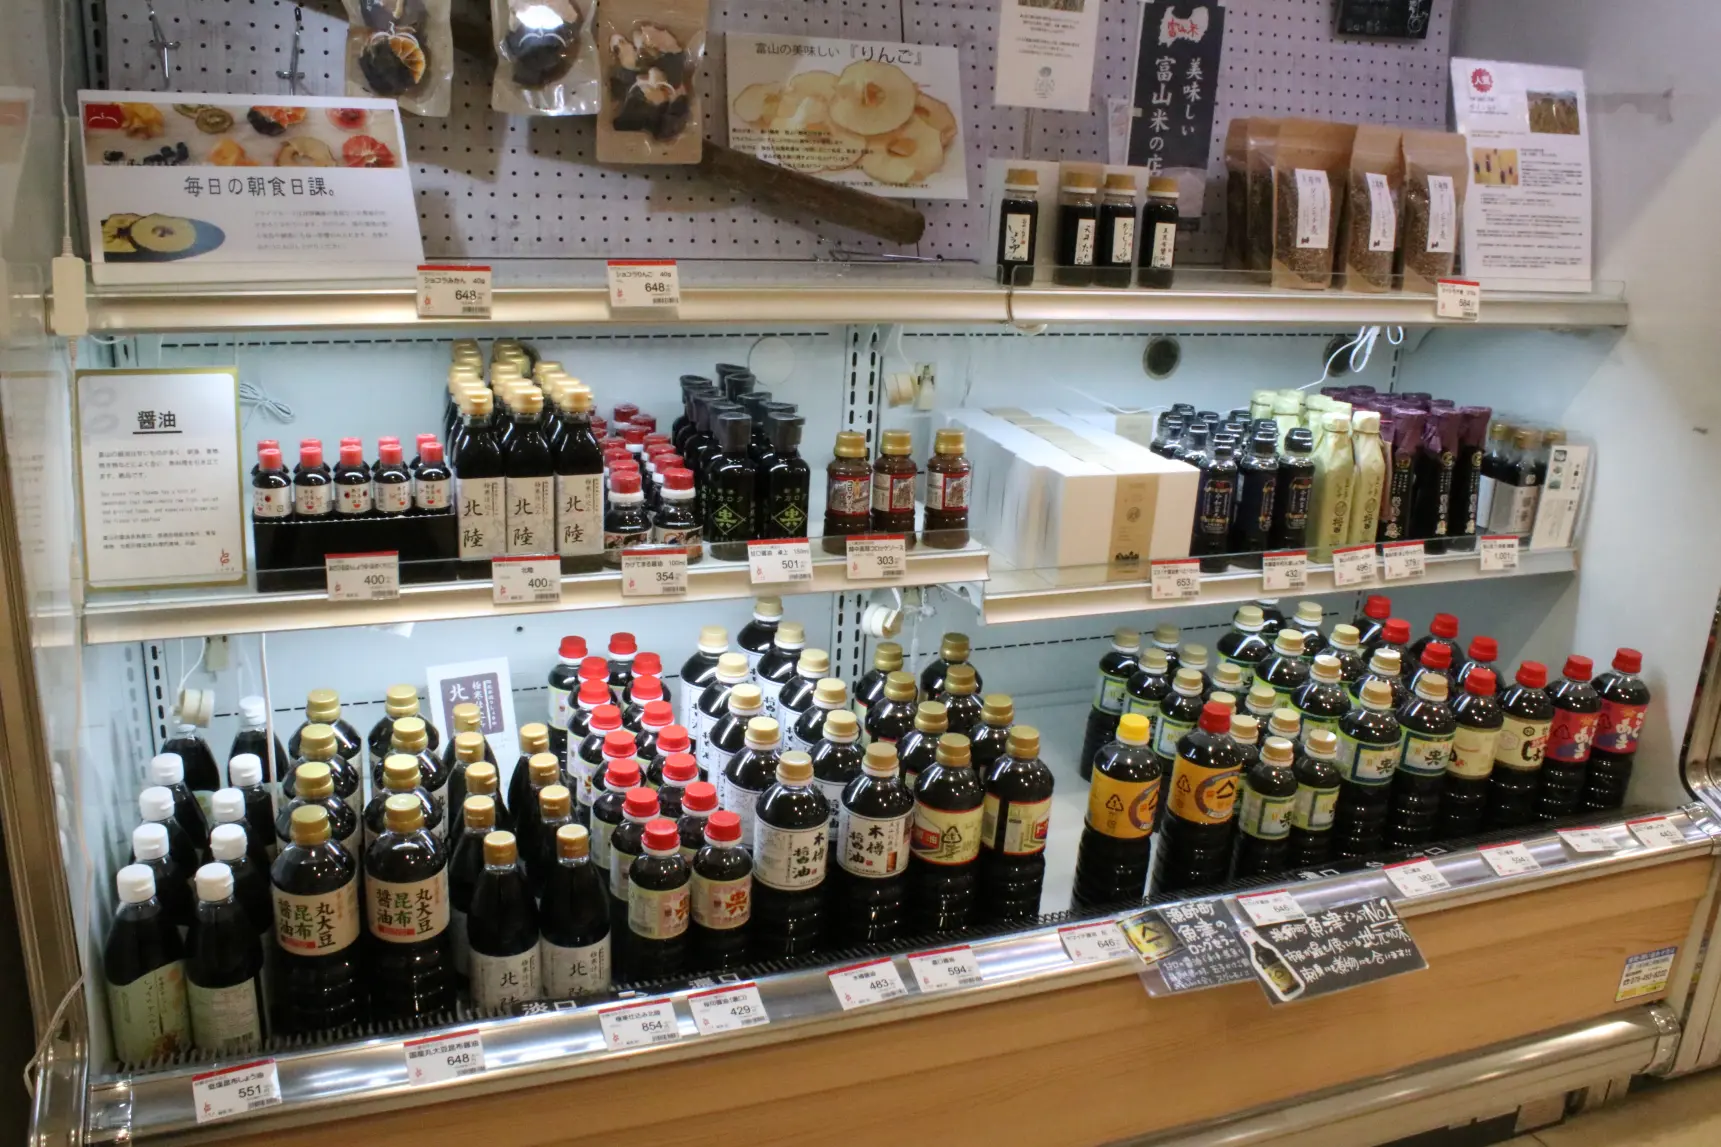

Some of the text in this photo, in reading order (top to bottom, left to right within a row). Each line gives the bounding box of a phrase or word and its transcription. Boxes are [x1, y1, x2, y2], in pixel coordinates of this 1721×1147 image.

[755, 43, 840, 57] 富山の美味しい
[1182, 58, 1203, 136] 美味しい
[1147, 56, 1176, 177] 富山米の店
[184, 176, 335, 197] 毎日の朝食日課。
[645, 282, 665, 292] 648
[455, 289, 476, 300] 648
[137, 410, 177, 430] 醤油
[464, 499, 483, 548] 北陸
[514, 498, 533, 546] 北陸
[564, 495, 584, 543] 北陸
[782, 560, 799, 569] 501
[877, 556, 894, 565] 303
[364, 574, 385, 584] 400
[528, 578, 548, 588] 400
[656, 572, 674, 582] 354
[1177, 578, 1191, 586] 653
[394, 892, 413, 927] 昆布
[416, 888, 434, 935] 丸大豆
[294, 904, 312, 940] 昆布
[315, 902, 336, 949] 丸大豆
[1098, 939, 1116, 948] 646
[948, 965, 967, 976] 594
[869, 979, 889, 990] 483
[730, 1006, 751, 1016] 429
[642, 1020, 663, 1032] 854
[447, 1053, 470, 1066] 648
[238, 1085, 261, 1098] 551
